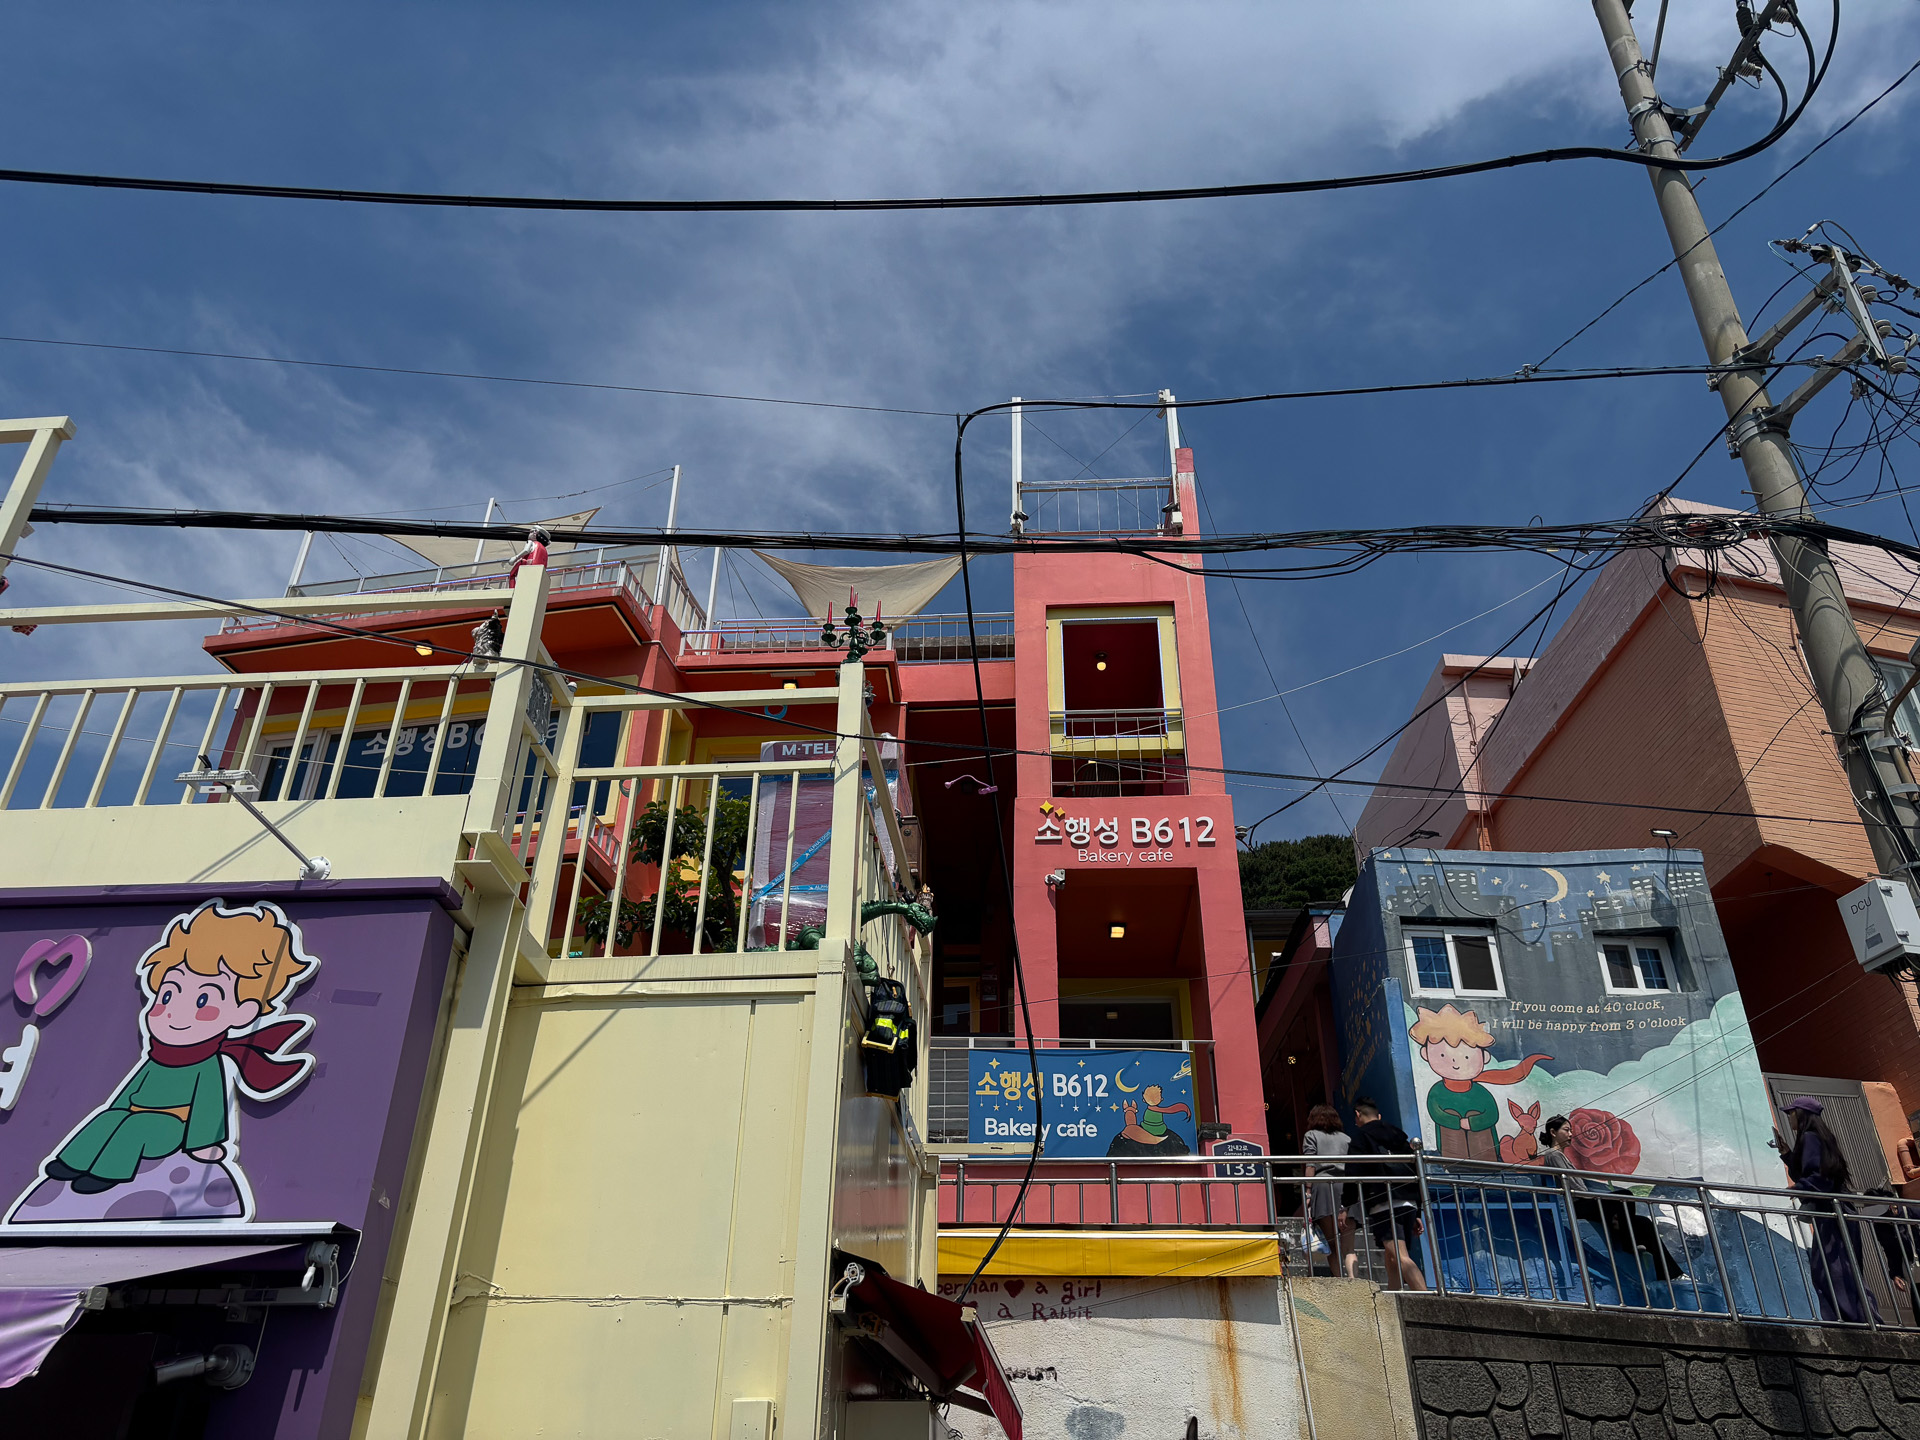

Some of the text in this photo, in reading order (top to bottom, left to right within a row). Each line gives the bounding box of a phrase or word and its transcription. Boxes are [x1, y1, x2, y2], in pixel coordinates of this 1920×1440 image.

[1035, 816, 1216, 845] 소행성 B612
[1078, 848, 1173, 865] Bakery cafe
[1850, 896, 1872, 915] DCU
[1510, 1001, 1521, 1011] If
[1522, 1003, 1546, 1014] you
[1550, 1004, 1583, 1014] come
[1586, 1004, 1600, 1014] at
[1492, 1016, 1686, 1033] I will be happy from 3 o'clock
[976, 1071, 1109, 1101] 소행성 B612
[984, 1117, 1098, 1142] Bakery cafe
[1222, 1163, 1256, 1176] 133
[1035, 1281, 1048, 1294] a
[998, 1302, 1093, 1321] a Rabbit
